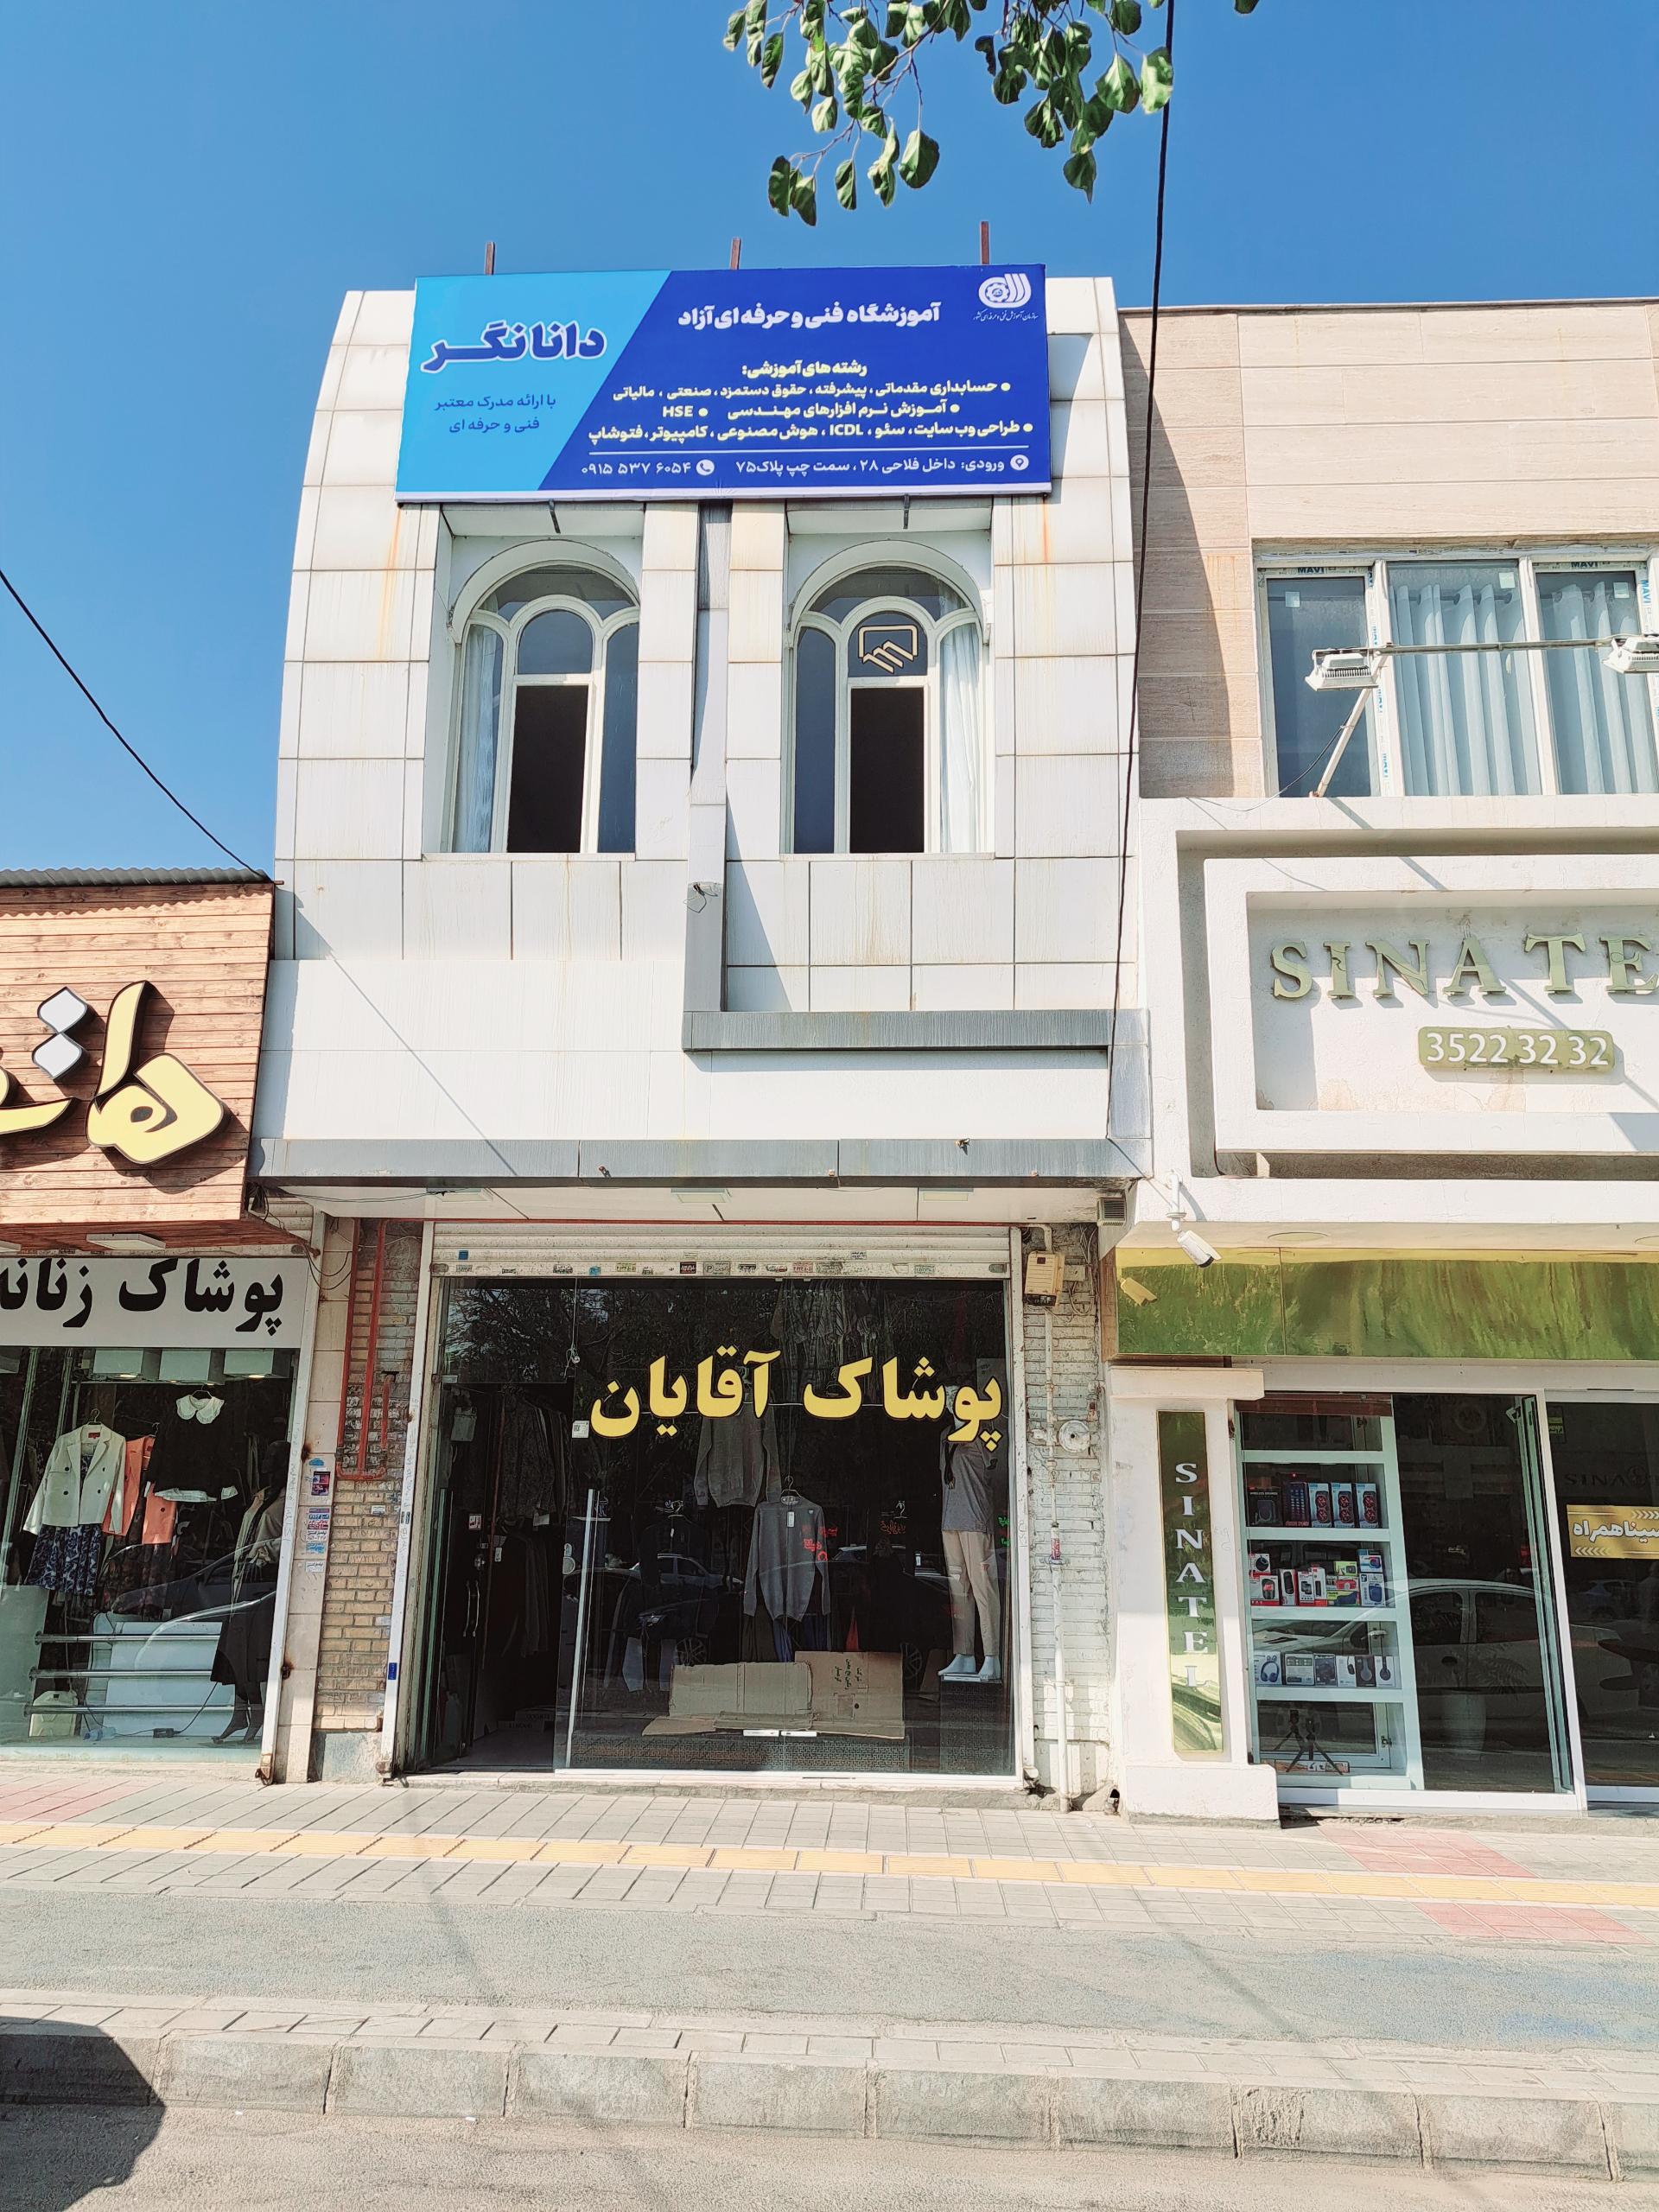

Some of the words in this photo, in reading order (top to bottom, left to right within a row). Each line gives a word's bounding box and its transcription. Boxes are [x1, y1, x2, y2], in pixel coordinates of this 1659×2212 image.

[677, 304, 715, 330] آزاد
[741, 302, 791, 329] حرفه
[804, 301, 844, 329] فنی
[846, 301, 942, 327] آموزشگاه
[420, 320, 607, 373] دانانگر
[741, 359, 804, 379] آموزشی:
[801, 360, 831, 378] های
[831, 359, 868, 377] رشته
[613, 385, 655, 401] مالیاتی
[771, 384, 807, 398] حقوق
[930, 379, 998, 397] حسابداری
[434, 397, 474, 411] معتبر
[477, 396, 514, 410] مدرک
[517, 394, 543, 410] ارائه
[546, 394, 556, 408] با
[890, 398, 948, 418] آموزش
[662, 405, 694, 418] HSE
[728, 404, 801, 421] مهندسی
[803, 400, 856, 420] افزارهای
[858, 402, 888, 419] نرم
[448, 418, 465, 433] ای
[467, 417, 500, 431] حرفه
[504, 423, 512, 432] و
[514, 416, 540, 433] فنی
[779, 423, 818, 440] هوش
[955, 424, 976, 438] وب
[976, 420, 1020, 437] طراحی
[588, 424, 643, 446] فتوشاپ
[581, 462, 613, 475] ۰۹۱۵
[618, 462, 651, 475] ۵۳۷
[656, 461, 692, 475] ۶۰۵۴
[785, 462, 811, 477] چپ
[812, 460, 850, 472] سمت
[881, 457, 920, 474] فلاحی
[922, 458, 956, 473] داخل
[1642, 580, 1652, 604] MAVI
[1427, 1032, 1509, 1064] 3522
[1518, 1034, 1559, 1065] 32
[1568, 1035, 1609, 1065] 32
[118, 1258, 283, 1337] پوشاک
[589, 1344, 782, 1439] آقایان
[803, 1355, 1003, 1452] پوشاک
[1174, 1462, 1210, 1689] SINATEL
